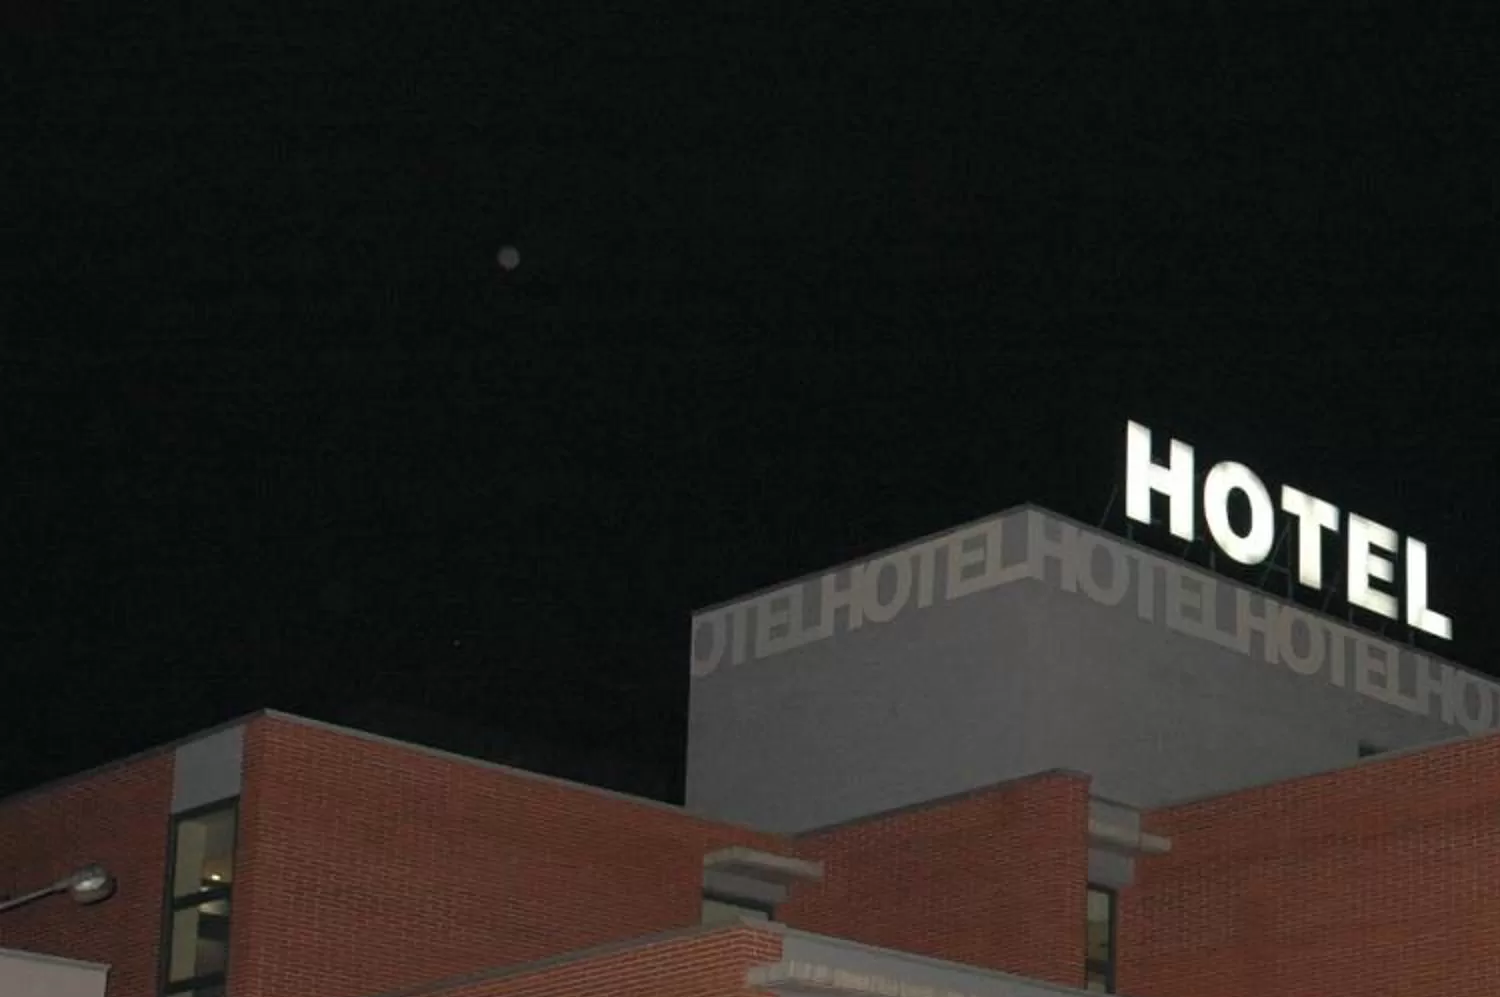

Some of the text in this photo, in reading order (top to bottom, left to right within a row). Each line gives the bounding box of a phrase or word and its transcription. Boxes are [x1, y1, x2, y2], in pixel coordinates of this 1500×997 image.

[820, 515, 1028, 637] HOTEL
[1028, 510, 1250, 656] HOTEL
[1236, 588, 1428, 716] HOTEL
[1126, 421, 1451, 639] HOTEL
